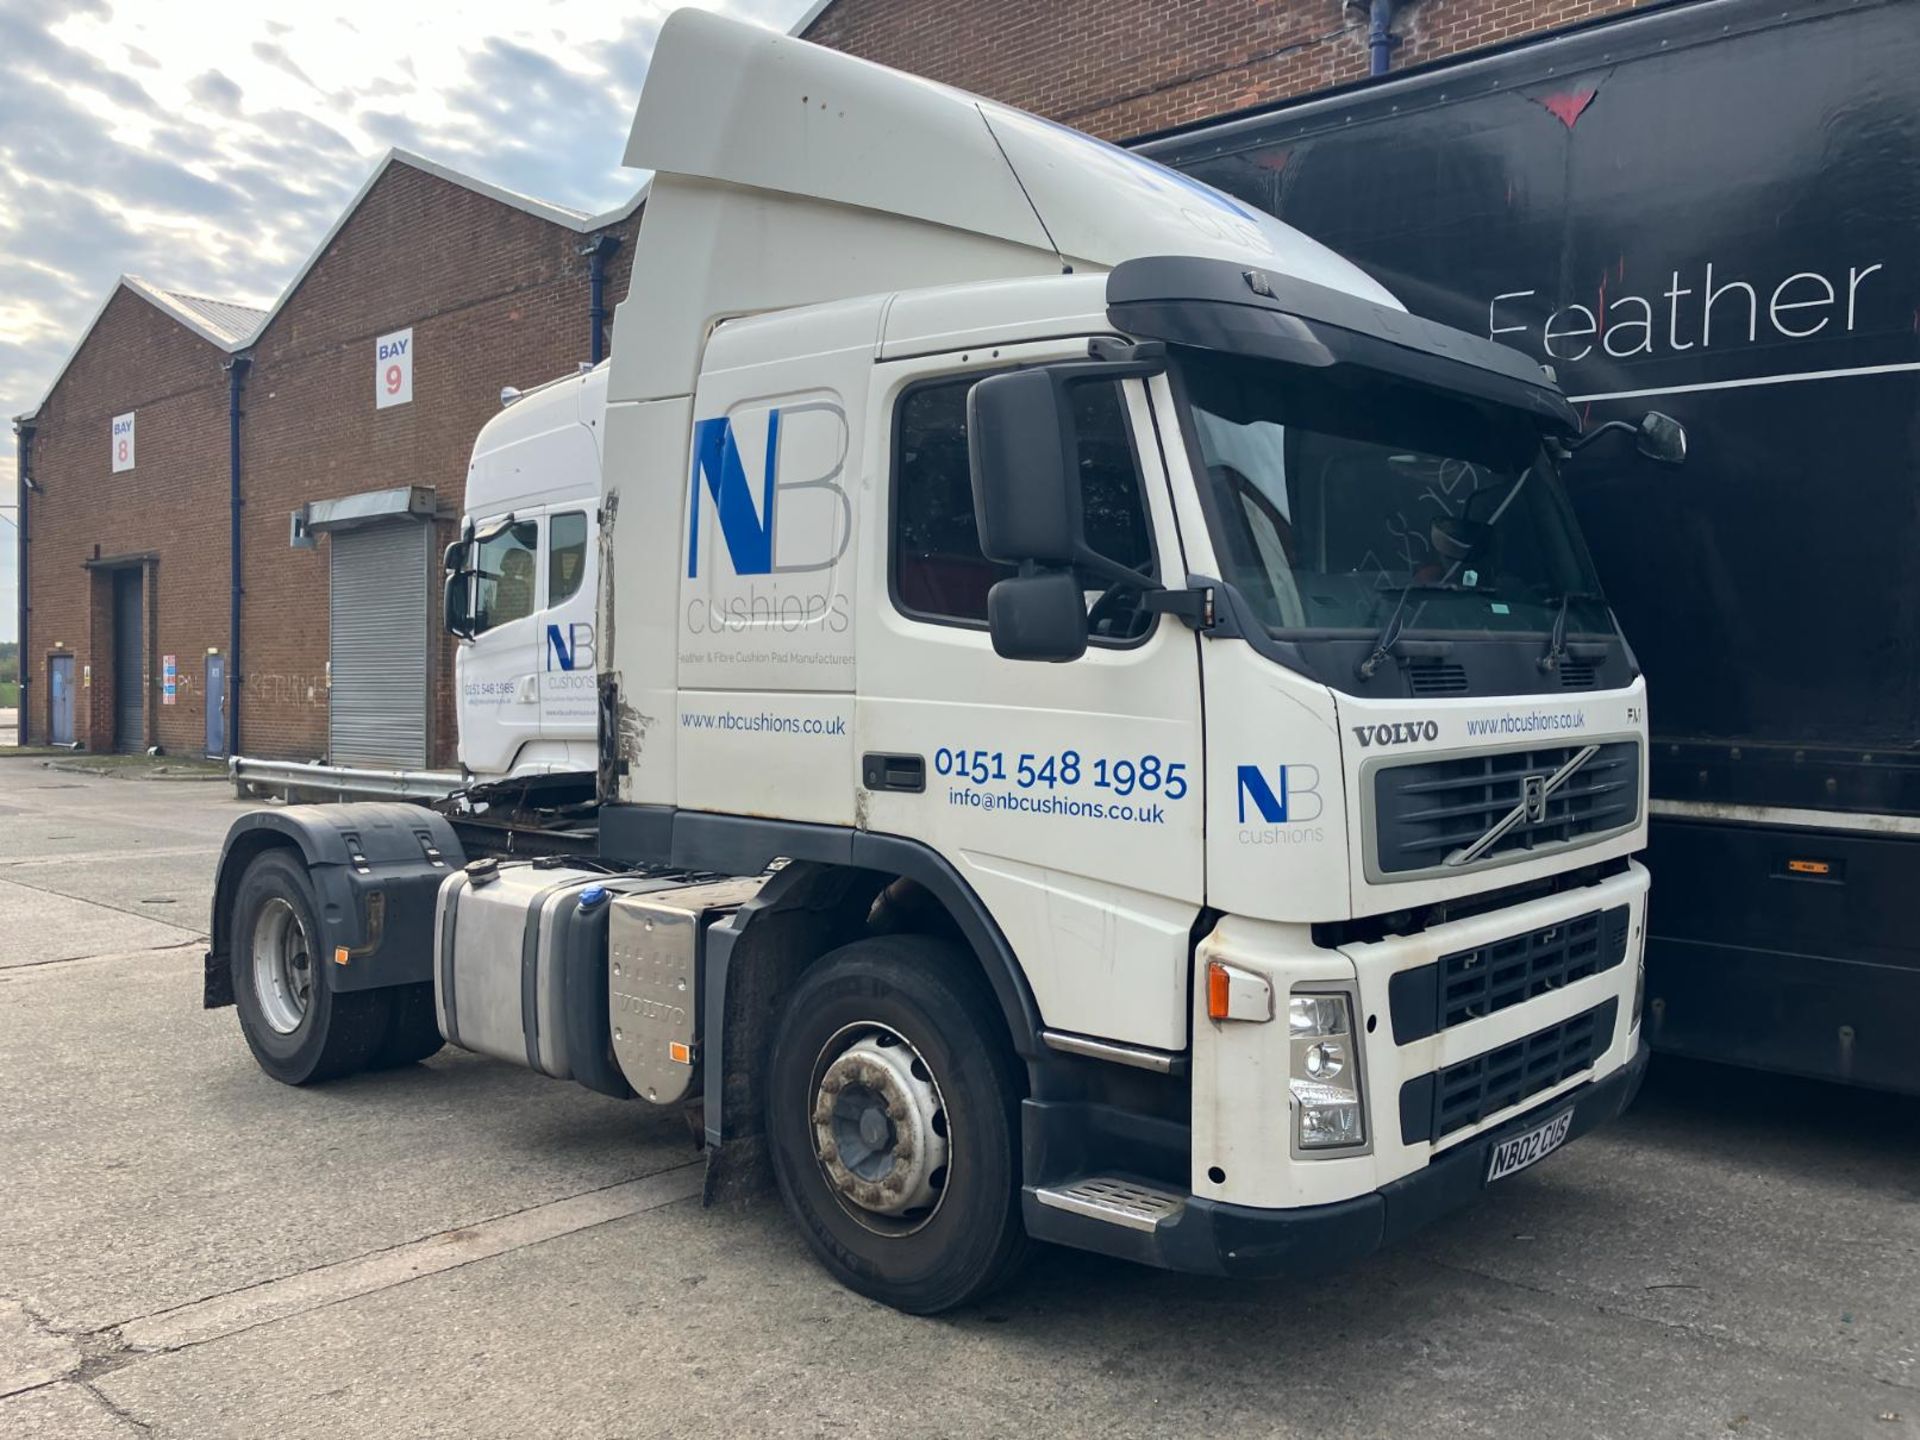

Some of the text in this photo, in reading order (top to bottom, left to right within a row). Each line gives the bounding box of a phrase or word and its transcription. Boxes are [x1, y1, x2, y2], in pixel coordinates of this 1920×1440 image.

[1490, 263, 1882, 361] Feather
[379, 339, 408, 360] BAY
[386, 364, 402, 395] 9
[114, 420, 132, 435] BAY
[118, 439, 128, 462] 8
[688, 402, 851, 578] NB
[687, 583, 849, 635] cushions
[547, 622, 595, 672] NB
[736, 652, 770, 664] Cushion
[771, 652, 788, 664] Pad
[681, 712, 846, 735] www.nbcushions.co.uk
[1352, 720, 1439, 747] VOLVO
[1467, 710, 1585, 735] www.nbcushions.co.uk
[935, 747, 1188, 800] 0151 548 1985
[949, 787, 1165, 824] info@nbcushions.co.uk
[1237, 764, 1324, 823] NB
[1238, 826, 1324, 845] cushions
[614, 991, 686, 1025] VOLVO
[1492, 1114, 1569, 1175] NB02 CUS
